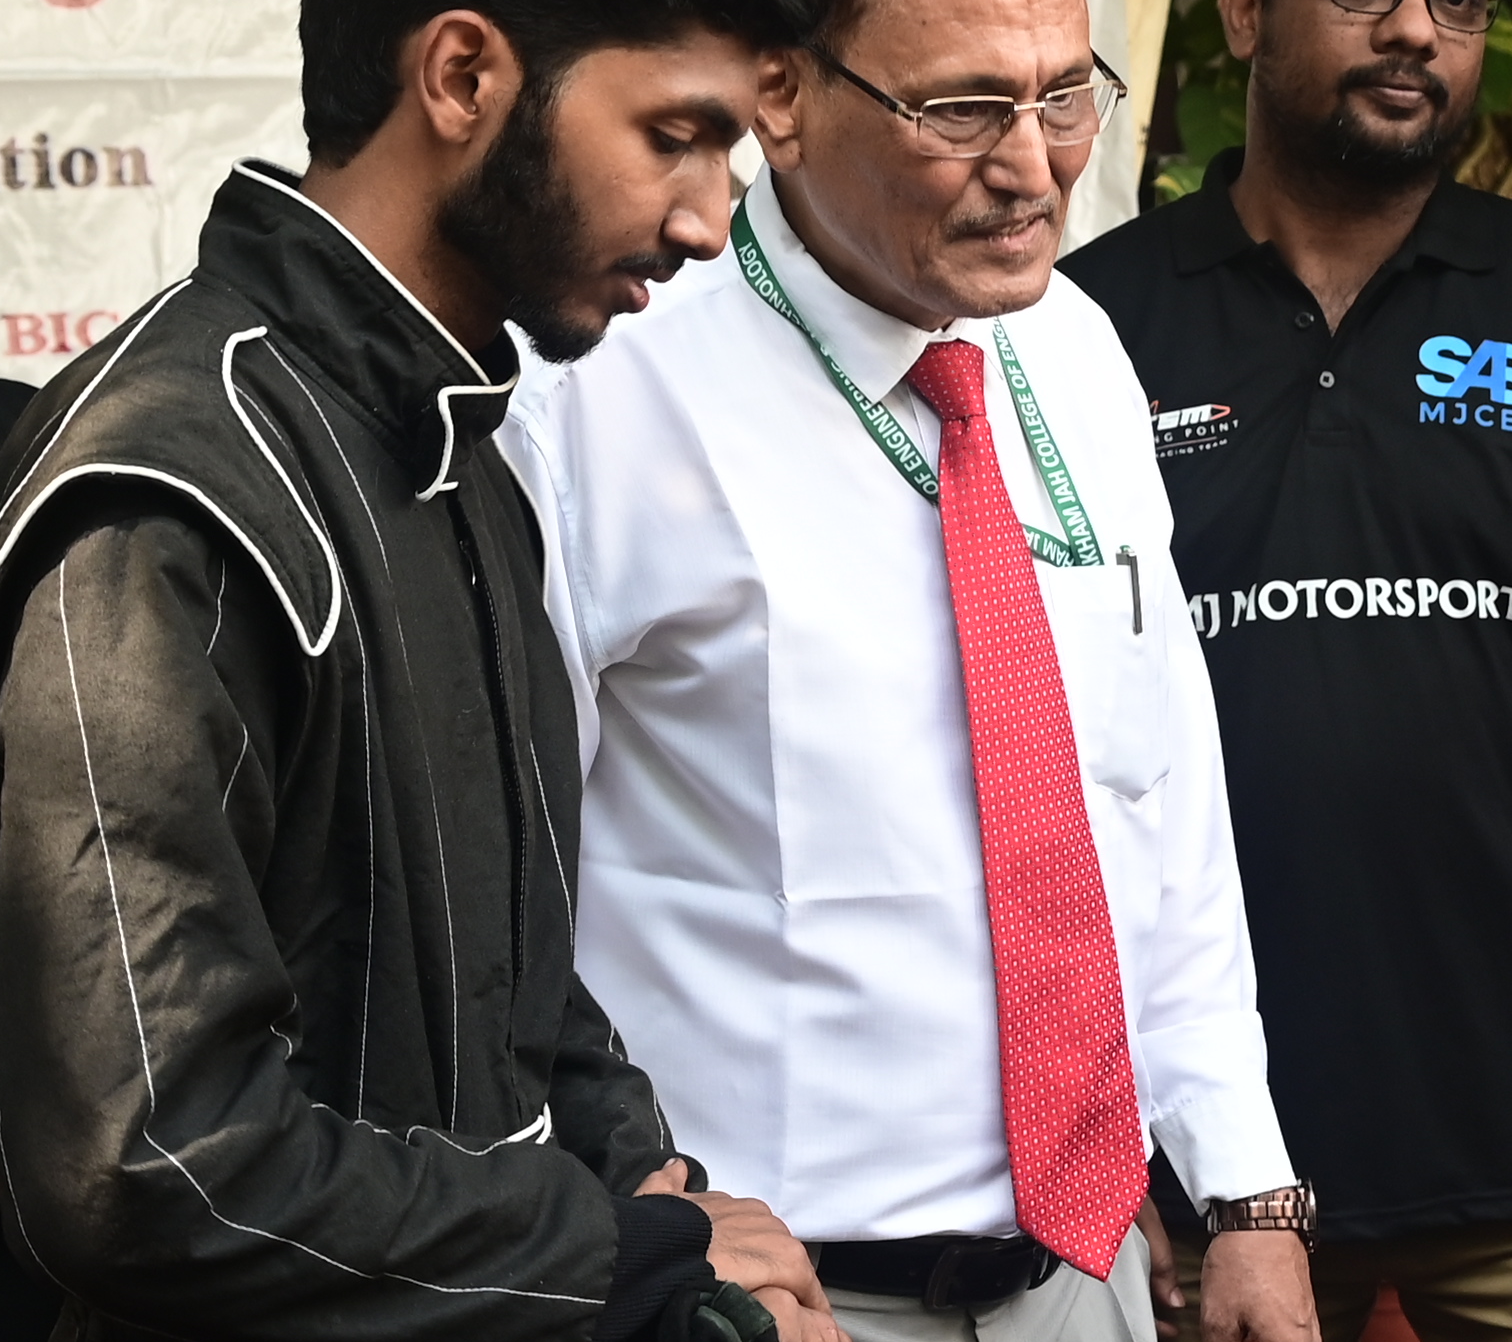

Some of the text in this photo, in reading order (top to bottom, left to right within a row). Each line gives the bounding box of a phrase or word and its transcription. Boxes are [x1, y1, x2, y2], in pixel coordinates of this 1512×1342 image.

[1007, 363, 1028, 389] OF
[1017, 392, 1060, 468] COLLEGE
[1047, 470, 1076, 504] JAH
